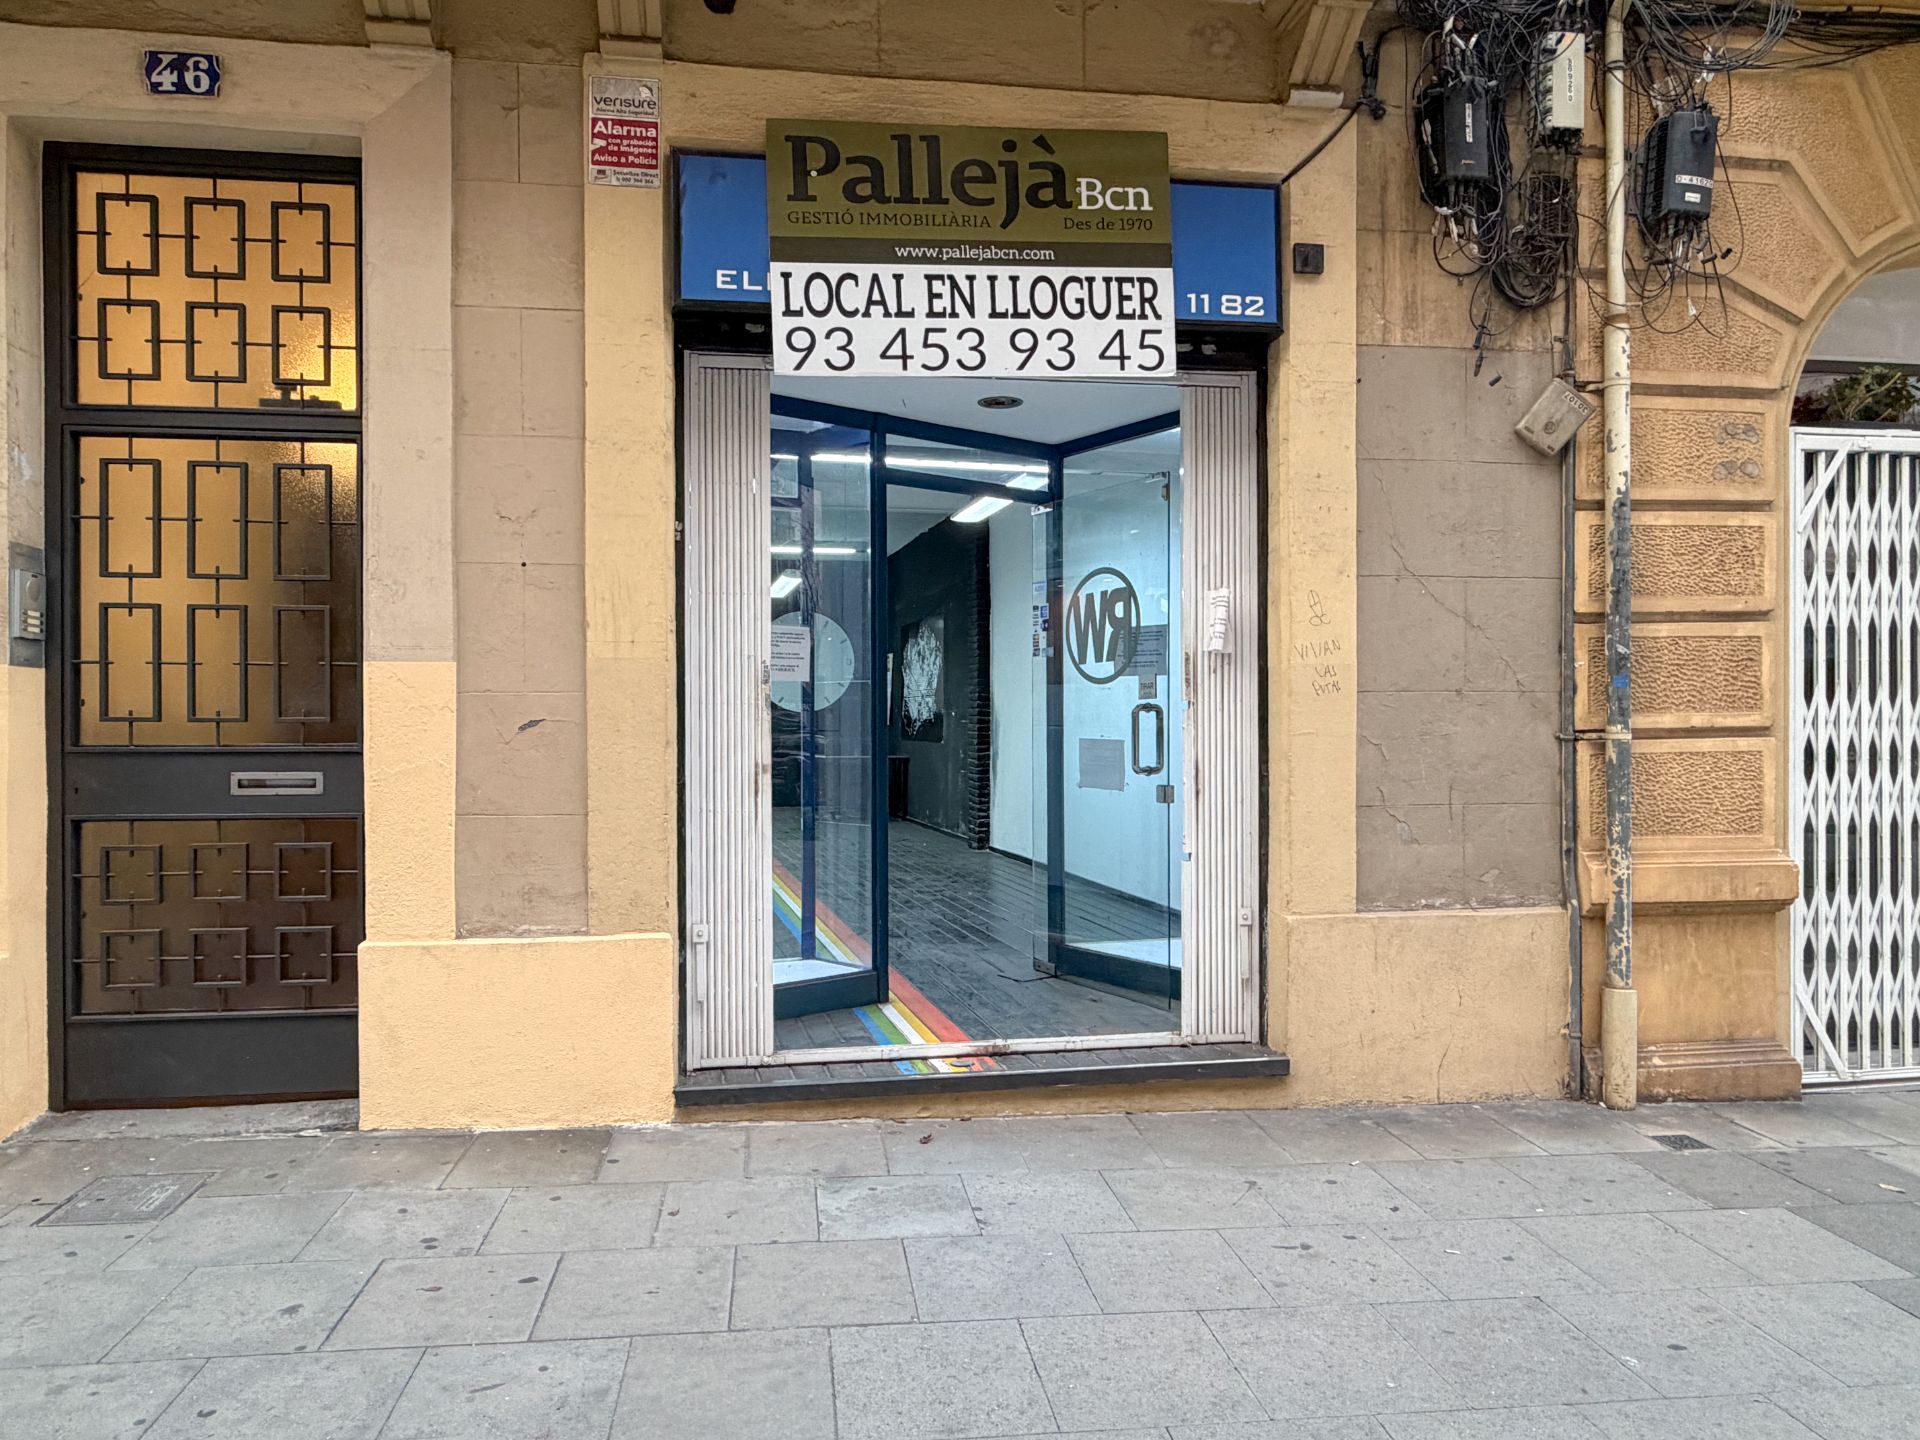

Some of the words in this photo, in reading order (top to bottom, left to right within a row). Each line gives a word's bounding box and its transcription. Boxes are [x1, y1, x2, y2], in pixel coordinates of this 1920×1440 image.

[150, 53, 210, 93] 46
[593, 96, 657, 110] verisure
[593, 120, 657, 138] Alarma
[593, 153, 618, 163] Aviso
[784, 133, 1074, 230] Pallejà
[1075, 177, 1154, 211] Bcn
[787, 208, 854, 225] GESTIÓ
[859, 209, 992, 228] IMMOBILIÀRIA
[1063, 217, 1092, 230] Des
[1096, 217, 1115, 231] de
[1119, 217, 1153, 231] 1970
[894, 244, 1056, 262] www.pallejabcn.com
[716, 269, 771, 291] EL
[780, 271, 915, 319] LOCAL
[924, 273, 977, 319] EN
[986, 274, 1163, 320] LLOGUER
[785, 326, 856, 372] 93
[879, 327, 987, 372] 453
[1009, 327, 1076, 371] 93
[1098, 328, 1165, 372] 45
[1294, 639, 1341, 661] VIVIAN
